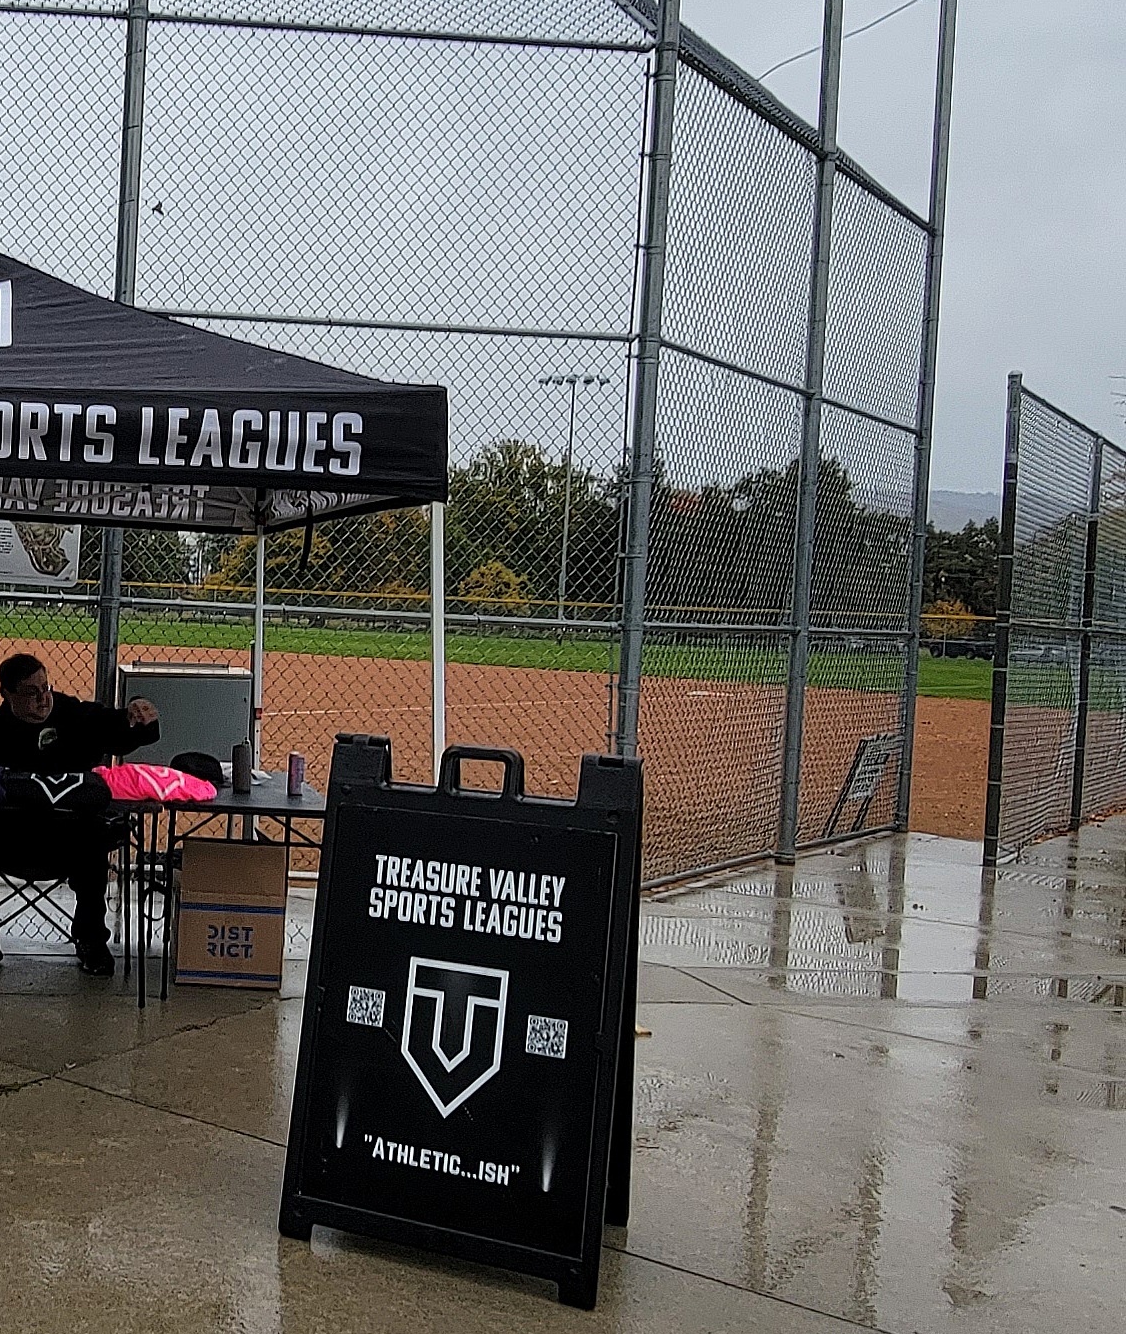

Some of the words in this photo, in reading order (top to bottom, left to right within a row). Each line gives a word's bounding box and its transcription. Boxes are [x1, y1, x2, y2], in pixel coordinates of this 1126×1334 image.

[137, 406, 364, 476] LEAGUES
[376, 854, 482, 897] TREASURE
[489, 868, 566, 908] VALLEY
[368, 887, 456, 928] SPORTS
[463, 899, 563, 943] LEAGUES
